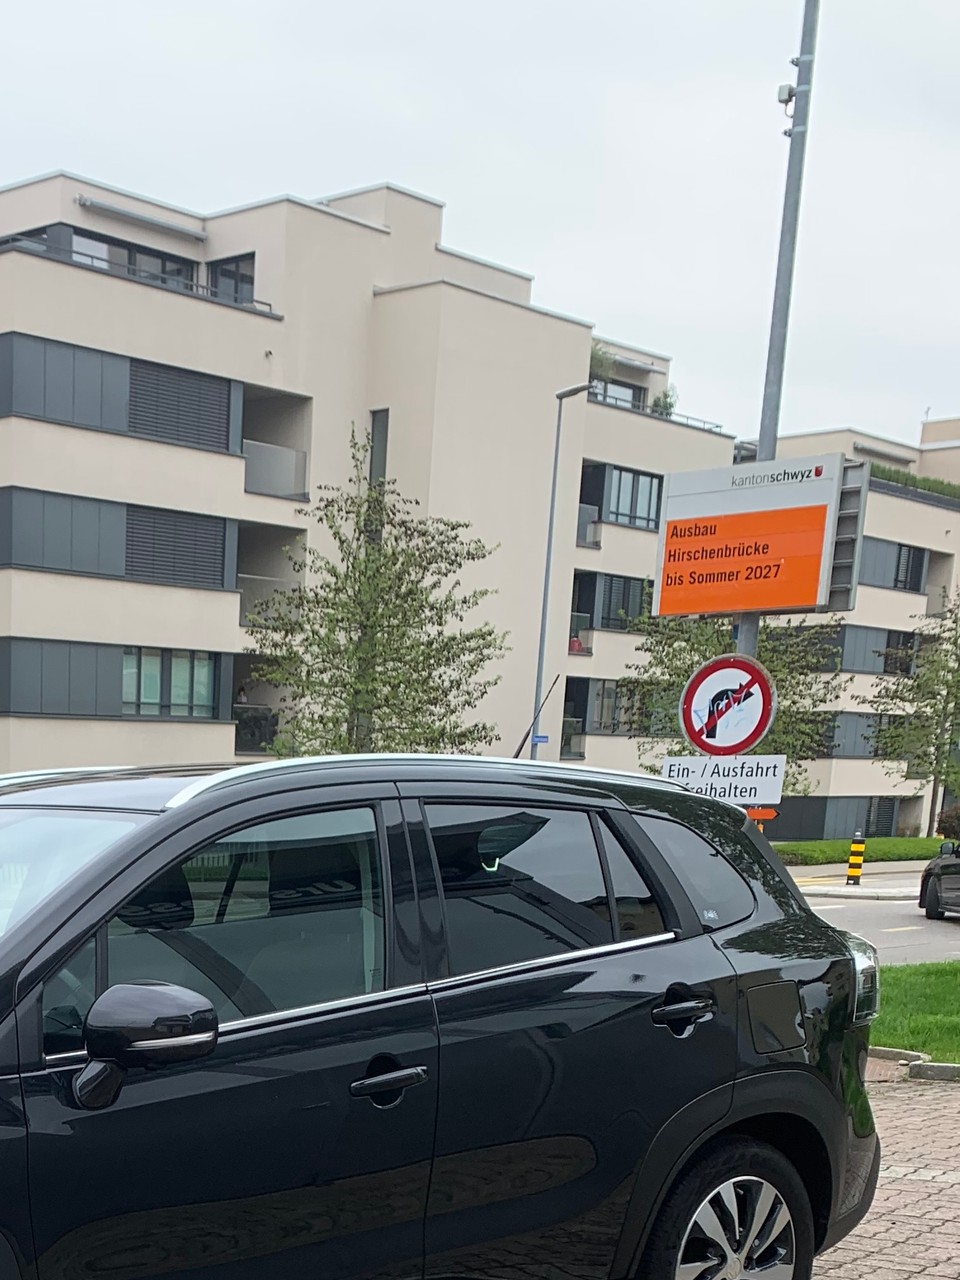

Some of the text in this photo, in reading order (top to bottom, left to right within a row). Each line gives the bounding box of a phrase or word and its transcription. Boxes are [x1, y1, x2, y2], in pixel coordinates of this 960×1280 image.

[731, 468, 813, 488] kantonschwyz
[670, 523, 717, 540] Ausbau
[667, 541, 770, 563] Hirschenbrücke
[665, 563, 781, 587] bis Sommer 2027
[667, 763, 696, 779] Ein-
[710, 761, 779, 778] Ausfahrt
[685, 782, 758, 798] reihalten
